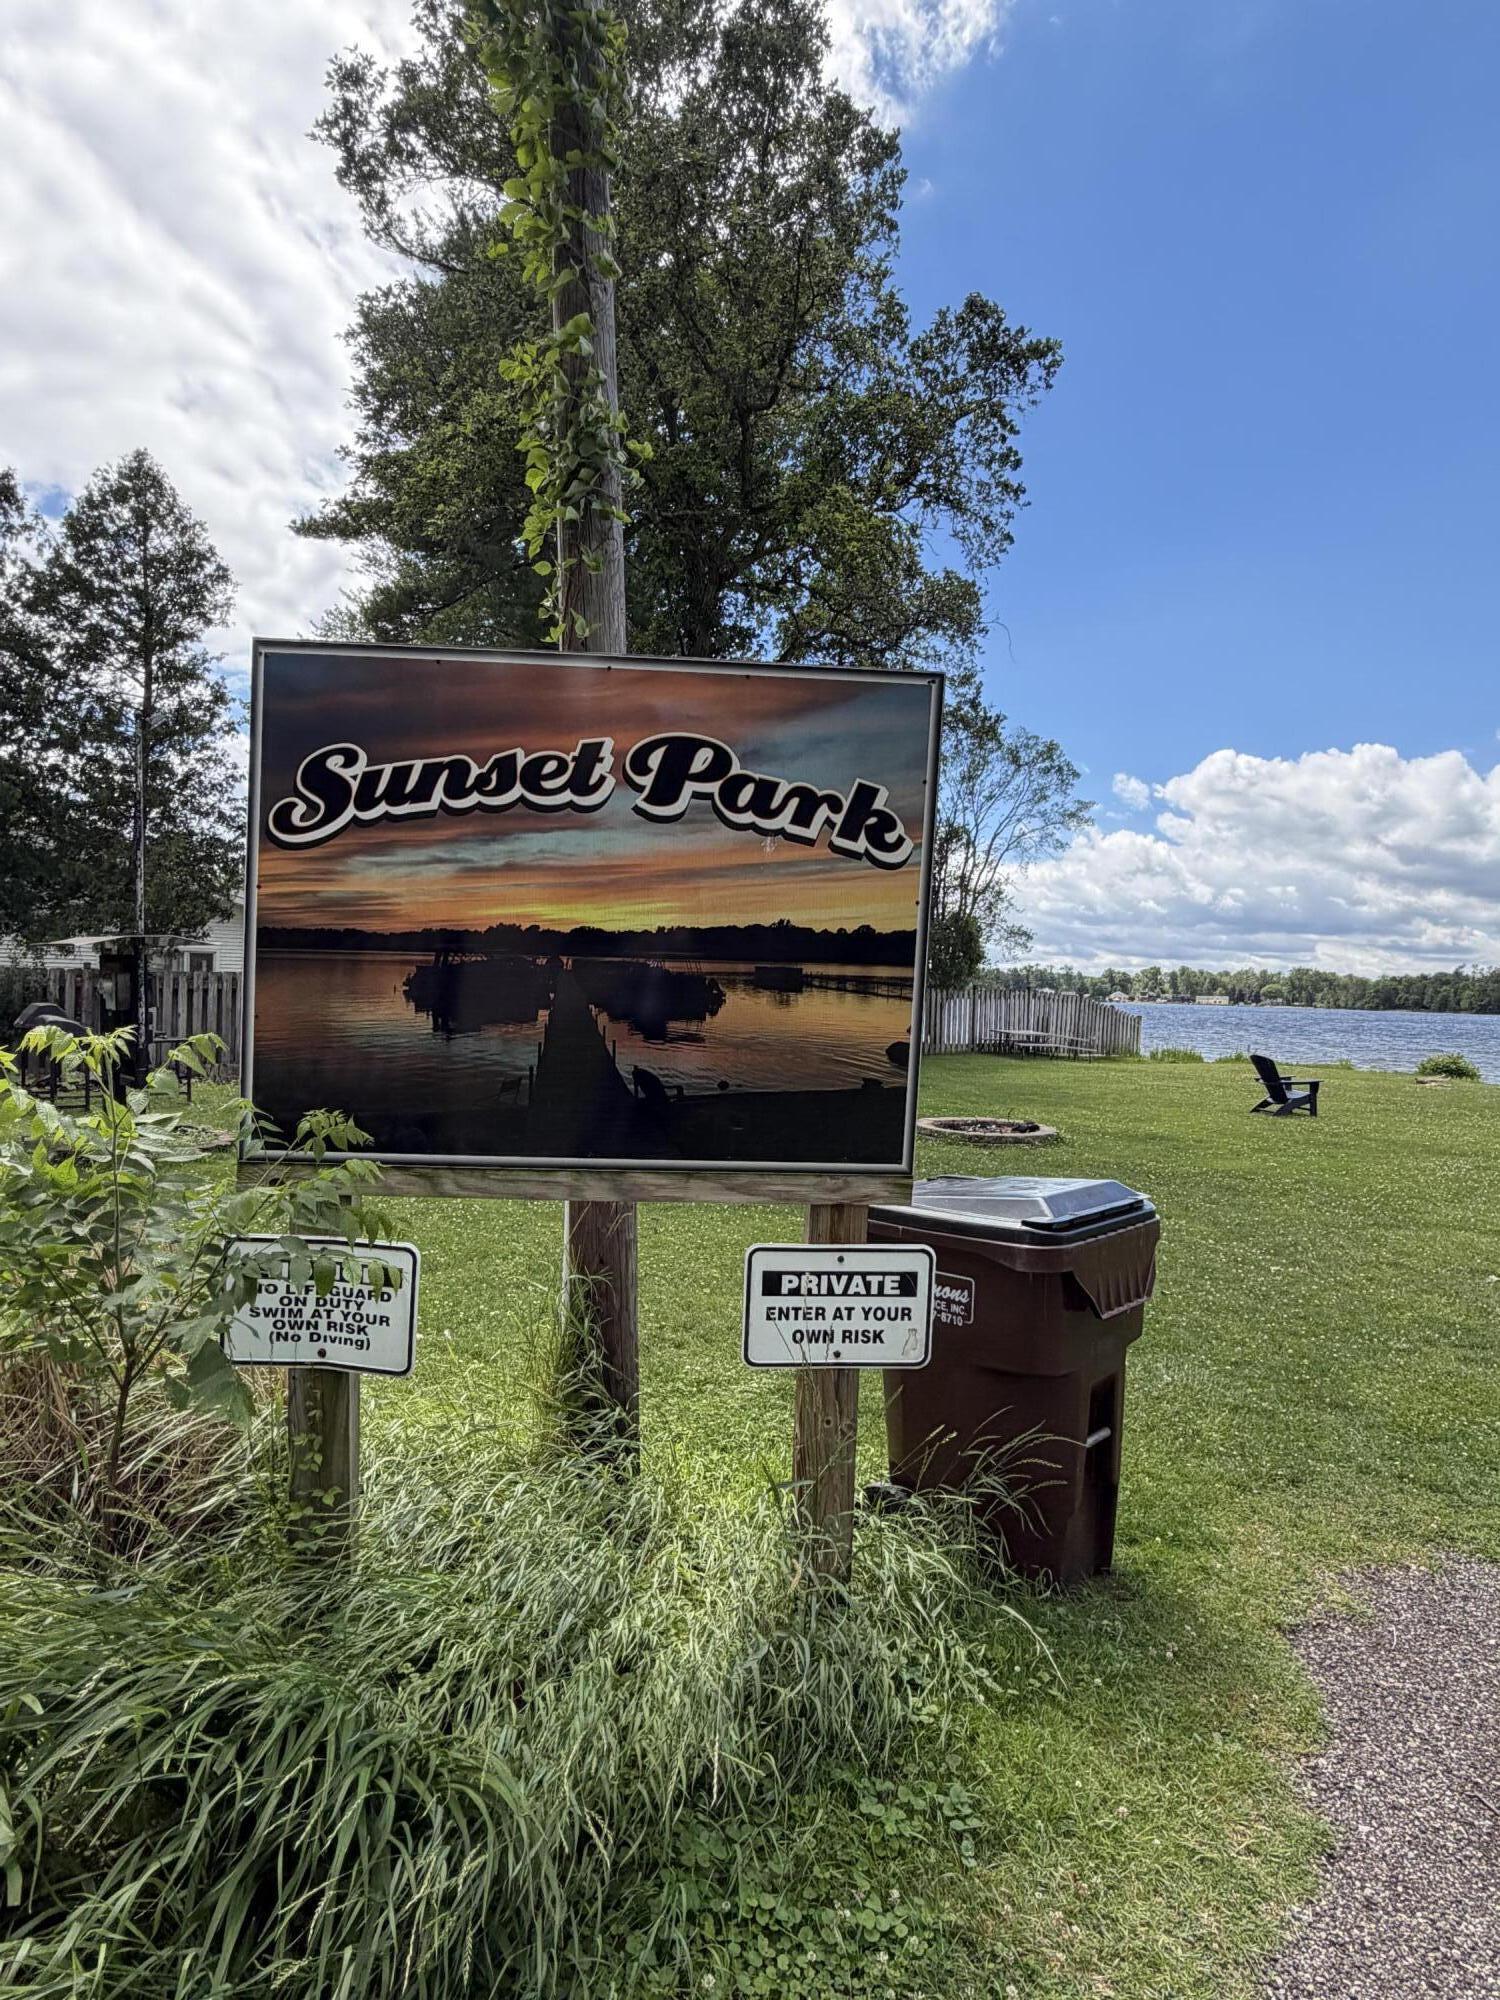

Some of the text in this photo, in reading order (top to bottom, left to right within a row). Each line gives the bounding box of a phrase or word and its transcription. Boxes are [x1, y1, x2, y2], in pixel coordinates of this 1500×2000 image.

[266, 733, 913, 870] Sunset Park
[781, 1274, 901, 1295] PRIVATE
[279, 1295, 365, 1311] ON DUTY
[249, 1306, 391, 1327] SWIM AT YOUR
[765, 1306, 912, 1322] ENTER AT YOUR
[272, 1319, 369, 1337] OWN RISK
[792, 1329, 885, 1344] OWN RISK
[269, 1331, 371, 1351] (No Diving)
